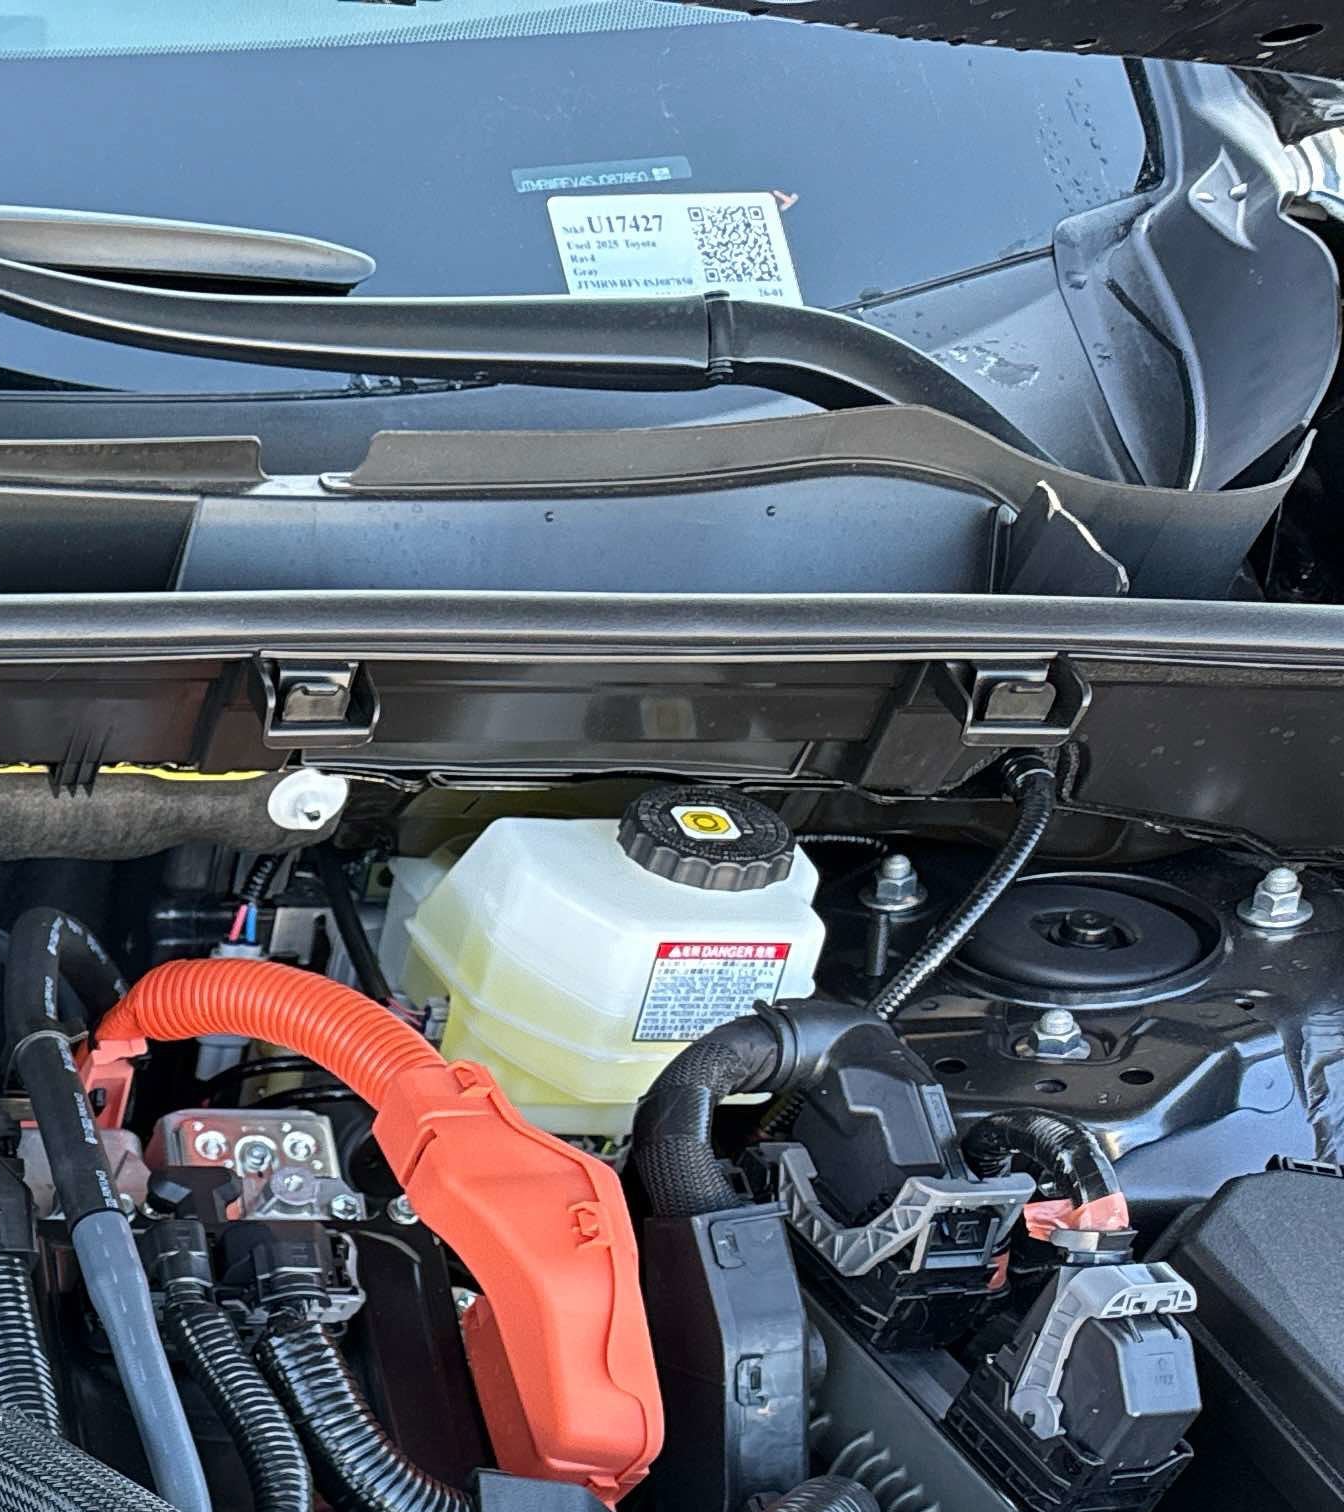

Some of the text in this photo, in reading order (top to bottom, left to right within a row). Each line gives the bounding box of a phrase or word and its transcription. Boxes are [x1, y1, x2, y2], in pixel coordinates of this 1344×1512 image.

[586, 214, 663, 233] U17427
[566, 240, 592, 251] Used
[624, 239, 657, 251] Toyota
[569, 253, 596, 264] Rav4
[572, 266, 598, 277] Gray
[702, 945, 754, 958] DANGER
